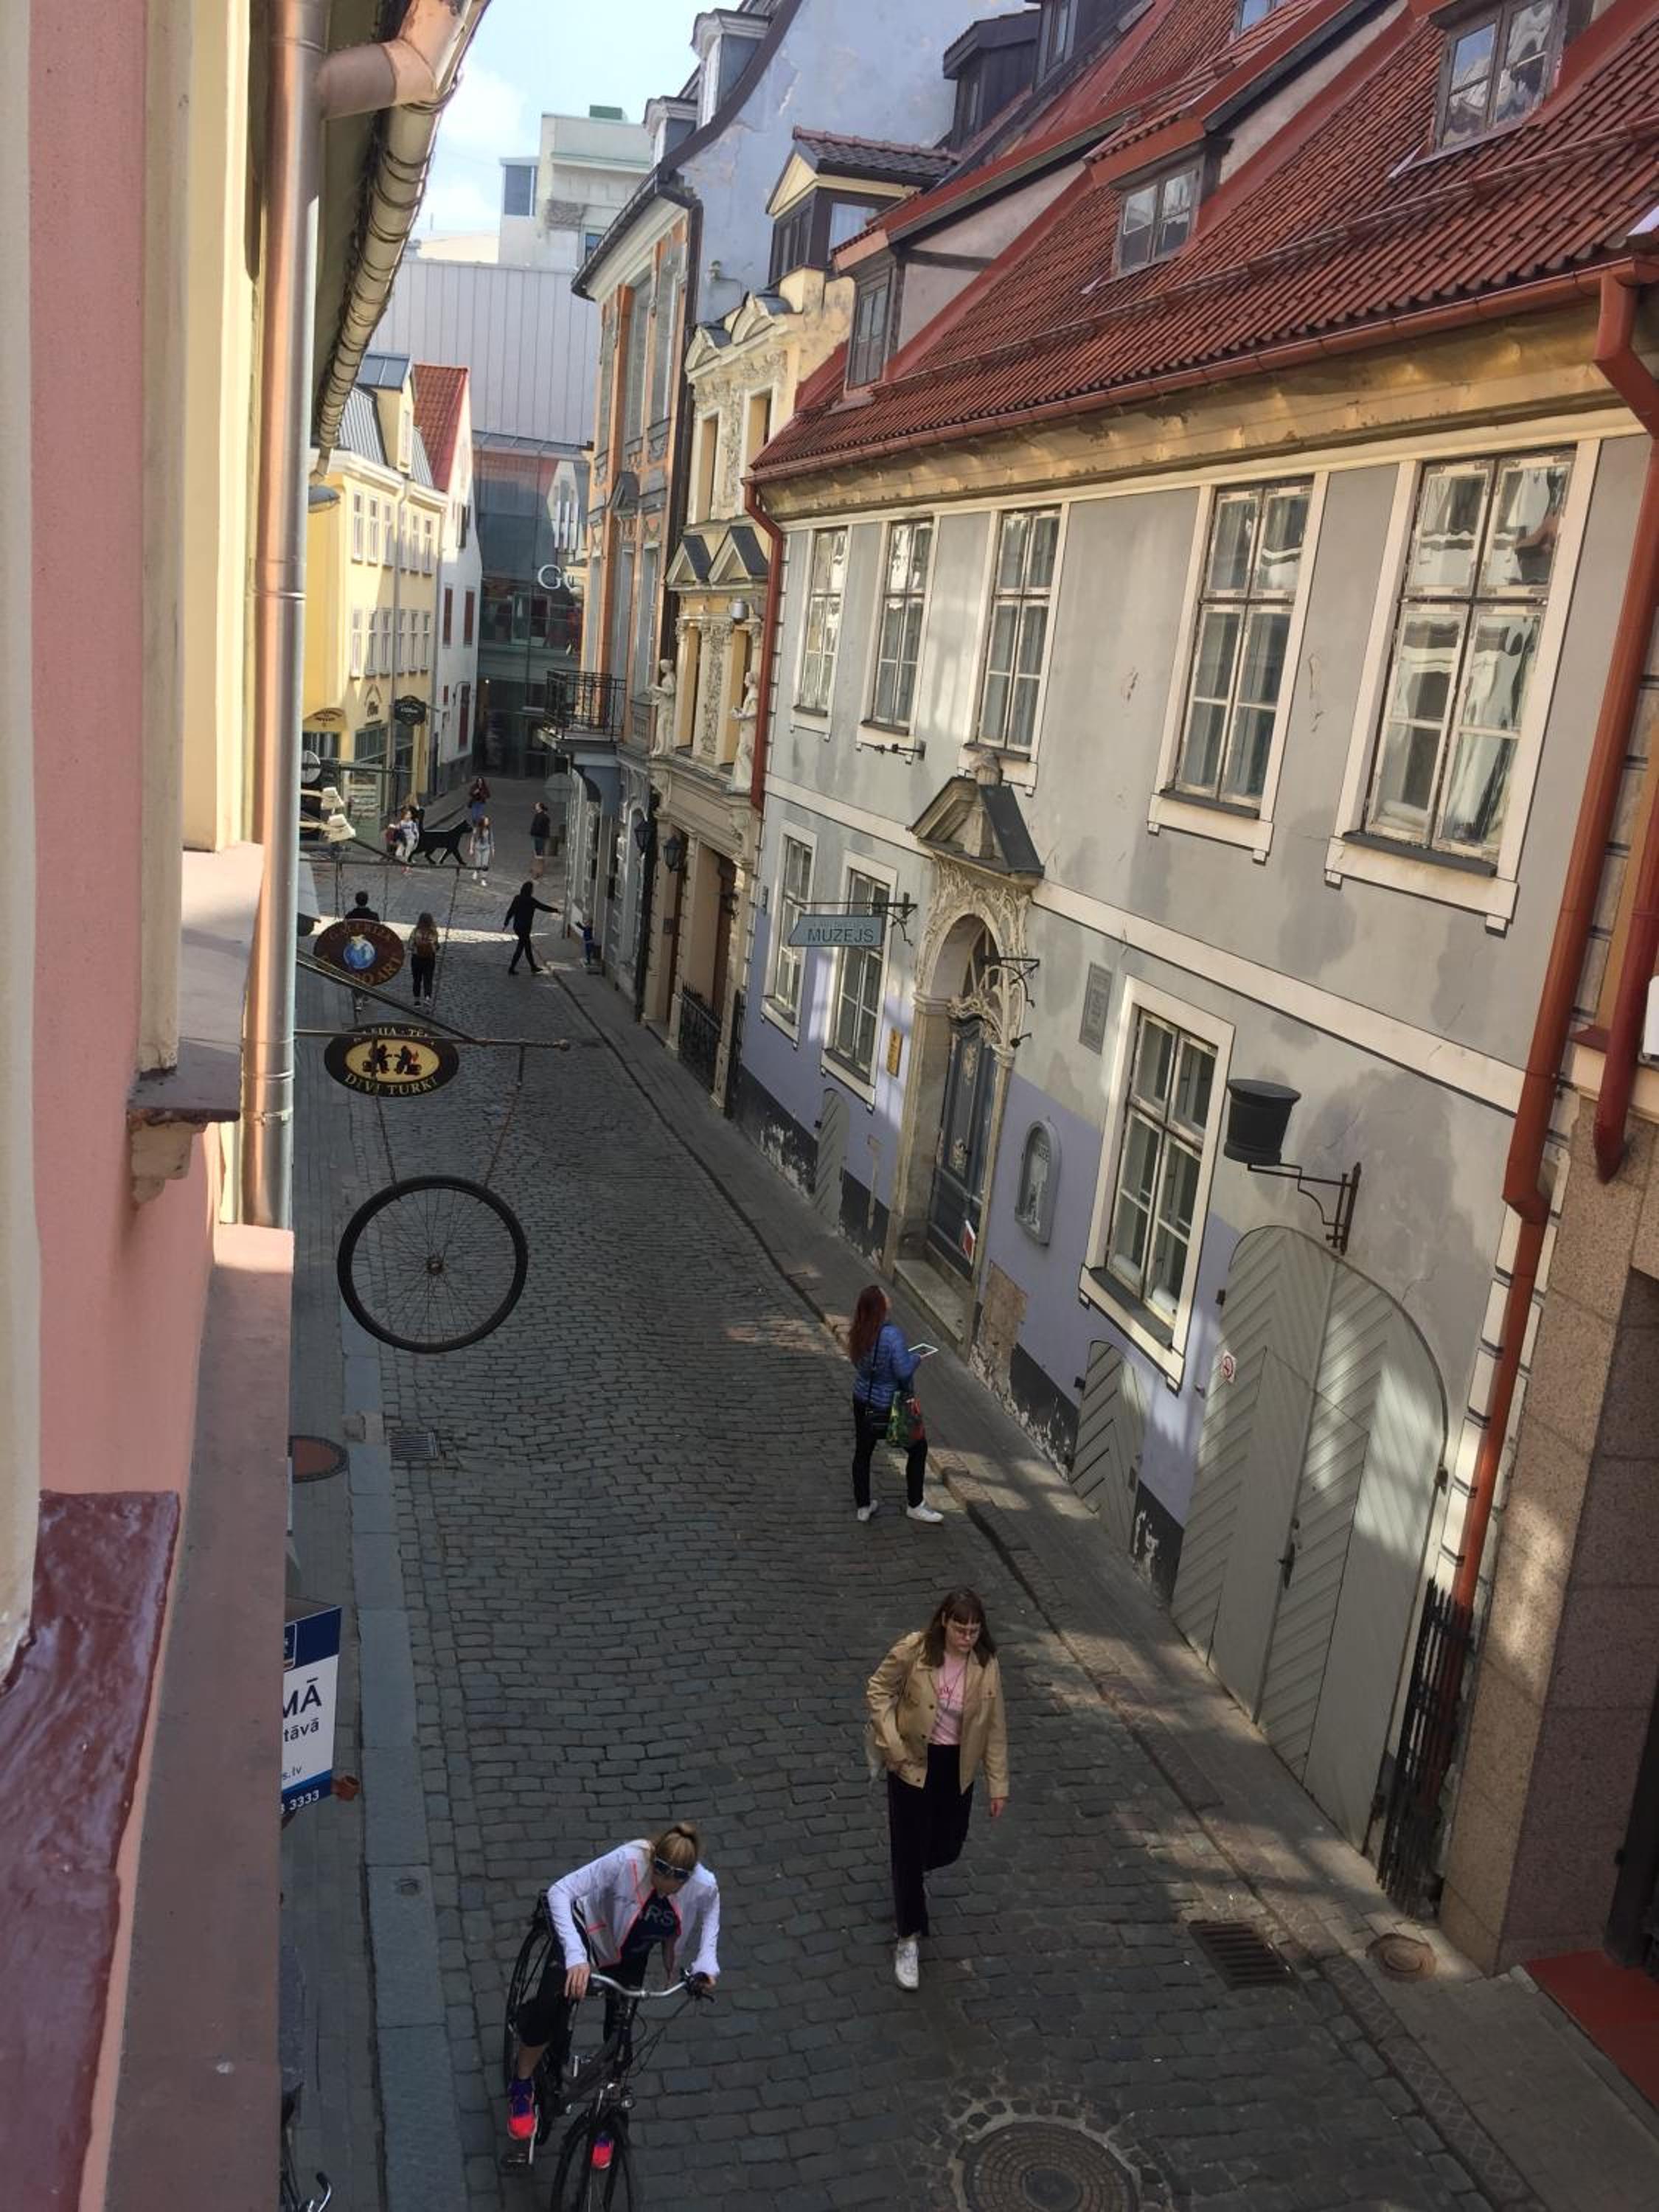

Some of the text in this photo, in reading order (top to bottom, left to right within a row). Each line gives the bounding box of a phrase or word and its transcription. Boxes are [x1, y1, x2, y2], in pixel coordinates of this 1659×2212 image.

[807, 928, 874, 943] MUZEJS
[344, 1074, 437, 1096] DIVI TURKI
[288, 1789, 319, 1811] 3333
[638, 1905, 674, 1927] RS
